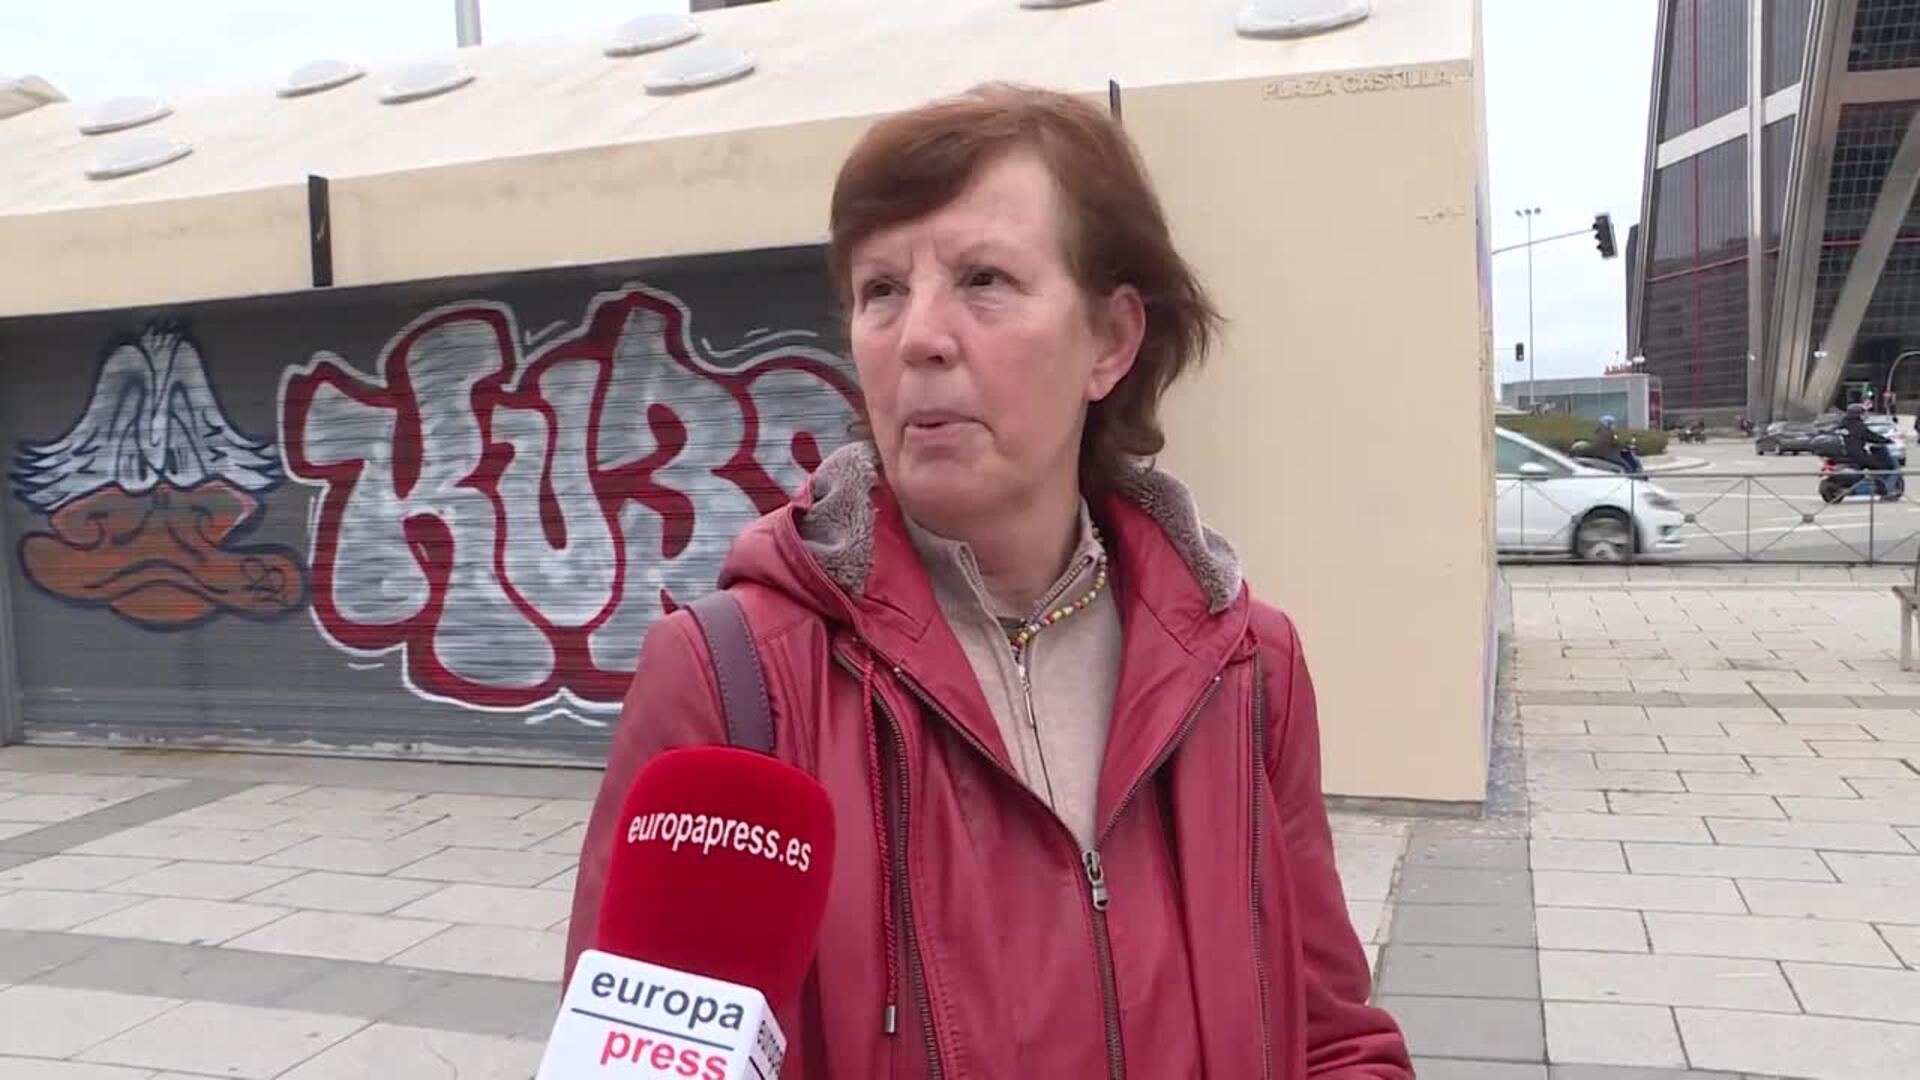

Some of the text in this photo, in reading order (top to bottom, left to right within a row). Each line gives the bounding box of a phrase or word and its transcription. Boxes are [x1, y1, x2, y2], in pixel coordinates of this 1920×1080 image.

[1262, 71, 1452, 101] PLAZA CASTILLA
[627, 812, 812, 872] europapress.es
[590, 969, 745, 1031] europa
[599, 1030, 728, 1080] press
